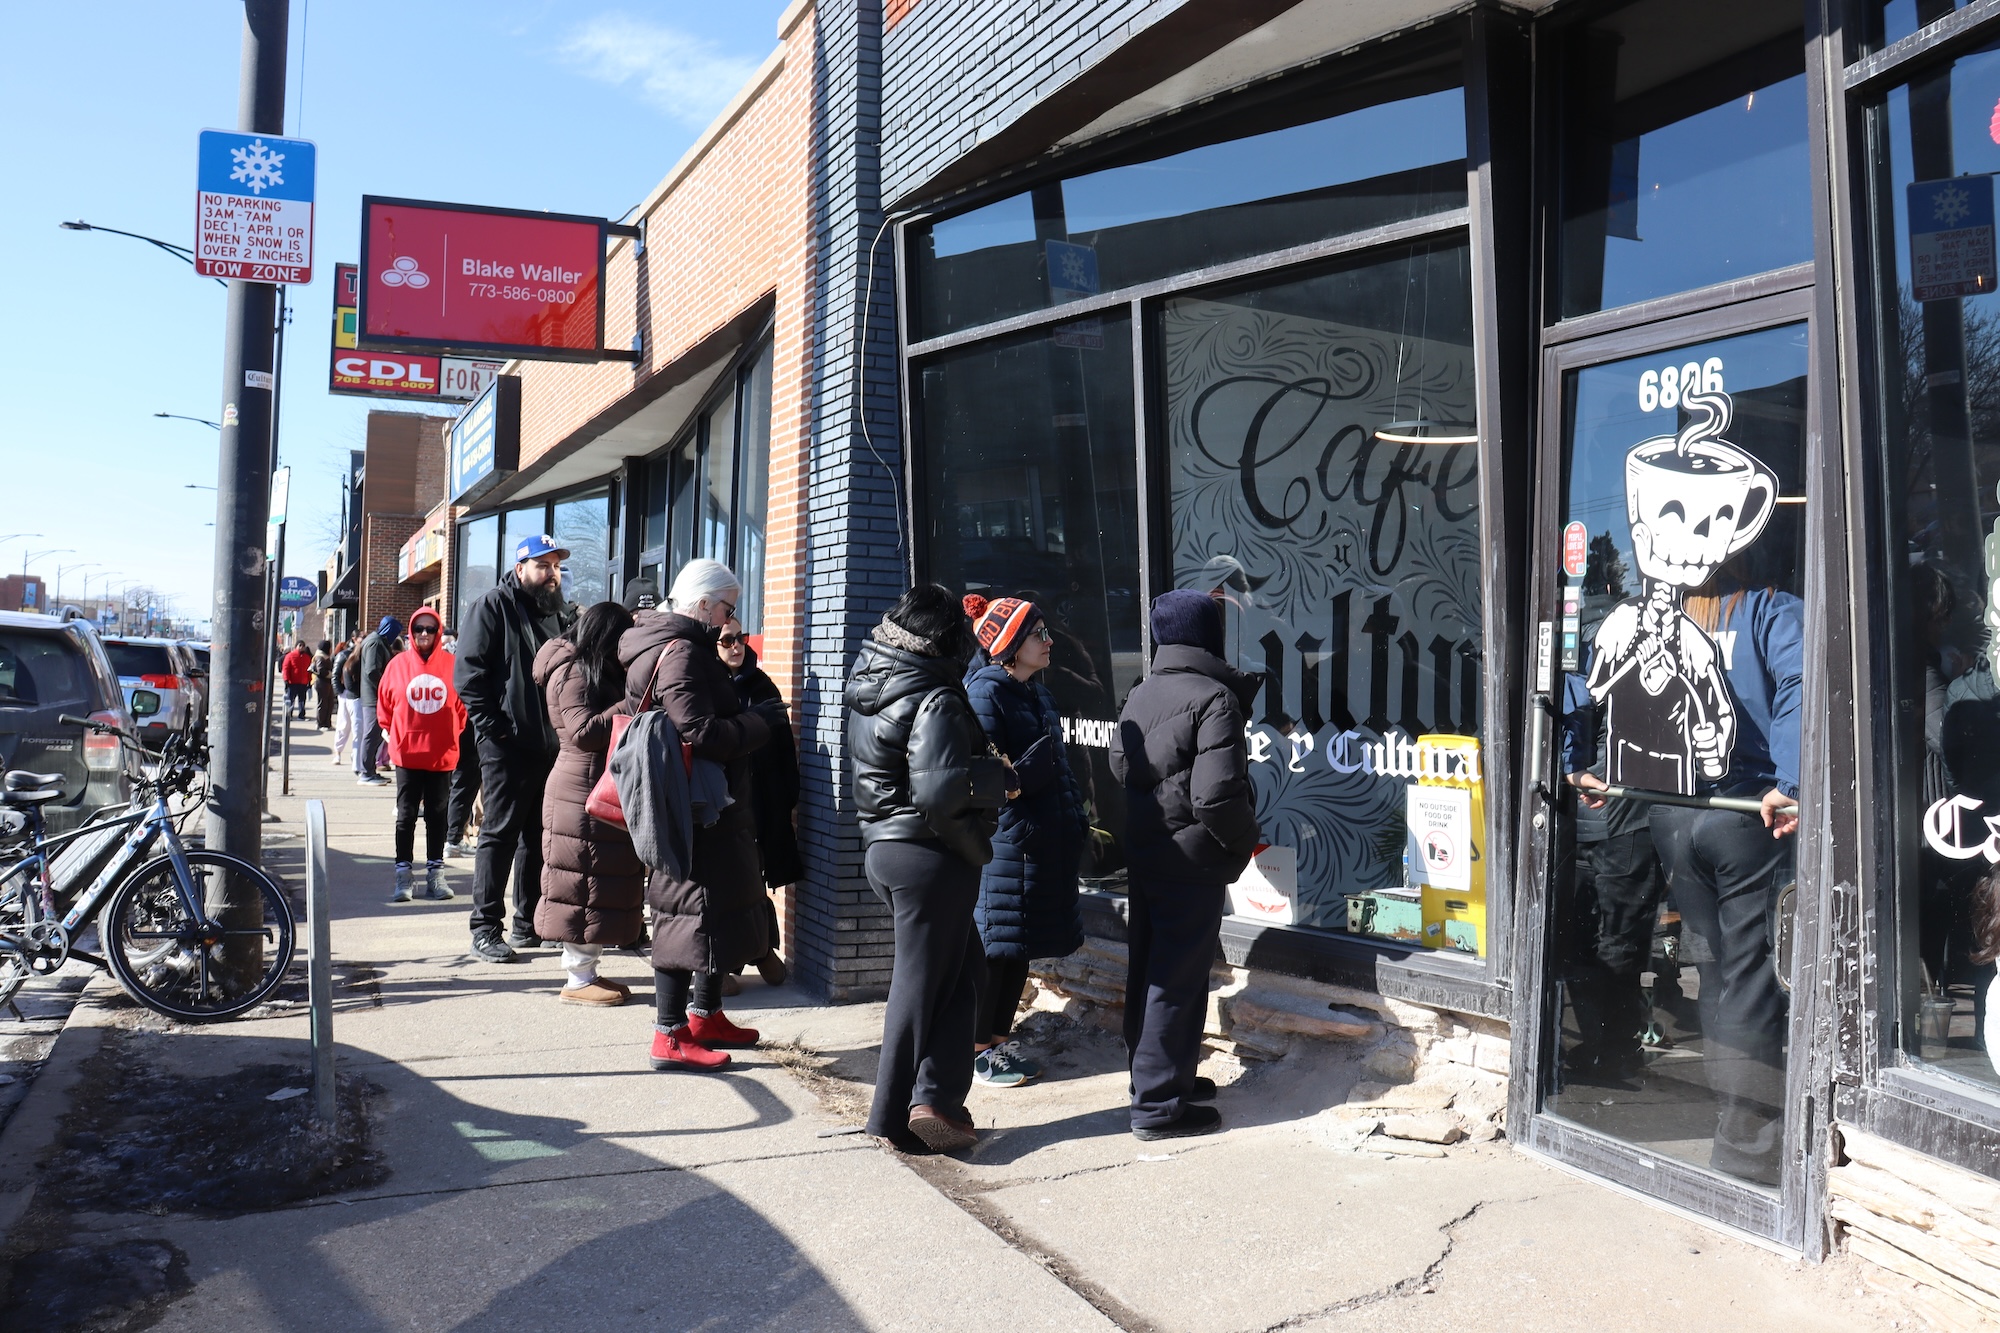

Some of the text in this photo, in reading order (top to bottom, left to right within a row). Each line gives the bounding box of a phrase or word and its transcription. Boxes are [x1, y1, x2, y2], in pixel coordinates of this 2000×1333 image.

[205, 195, 281, 211] NO PARKING
[204, 220, 228, 231] DEC
[278, 227, 281, 236] 1
[288, 228, 304, 238] OR
[204, 232, 300, 250] WHEN SNOW IS
[204, 245, 303, 263] OVER 2 INCHES
[203, 261, 300, 281] TOW ZONE
[462, 258, 582, 284] Blake Waller
[469, 283, 576, 304] 773-586-0800
[335, 358, 434, 383] CDL
[446, 368, 480, 391] FOR
[334, 376, 435, 390] 708-456-0007
[993, 597, 1023, 618] BE
[1540, 628, 1550, 667] PULL
[411, 687, 443, 701] UIC
[1076, 719, 1117, 748] HORCHAT
[1288, 730, 1314, 772] y
[1326, 730, 1482, 783] Cultura
[1431, 804, 1456, 812] OUTSIDE
